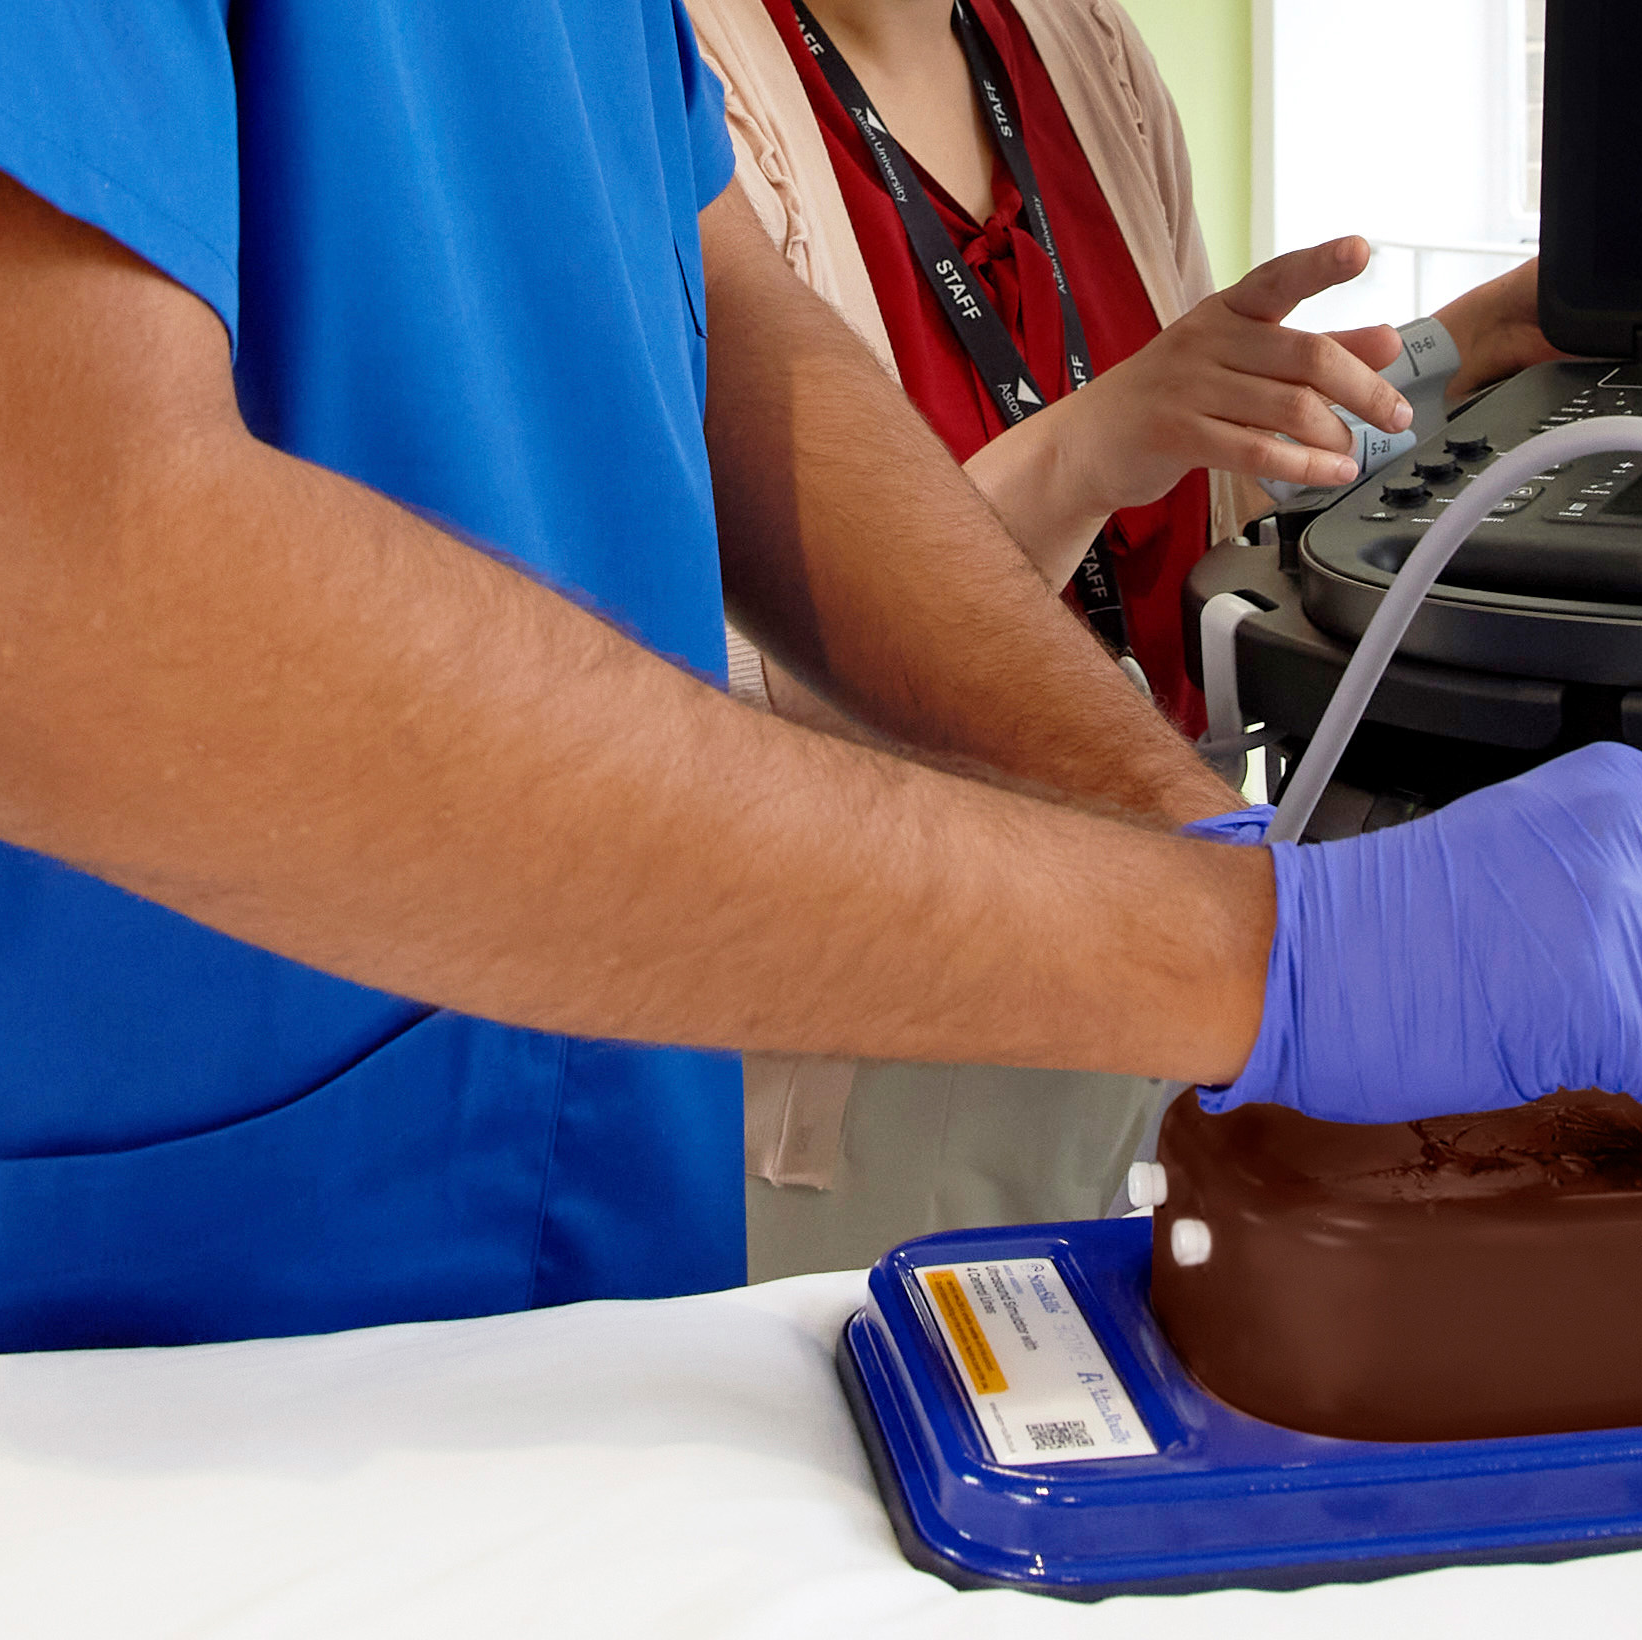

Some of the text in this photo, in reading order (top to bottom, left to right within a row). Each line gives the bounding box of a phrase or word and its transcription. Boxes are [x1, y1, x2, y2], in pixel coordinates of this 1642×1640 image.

[983, 79, 1013, 138] STAFF
[852, 107, 909, 203] Aston University
[935, 259, 982, 321] STAFF
[997, 382, 1026, 422] Aston
[1082, 547, 1109, 599] TAFF
[985, 1265, 1011, 1302] Ultrasound
[1004, 1299, 1029, 1335] Simulator
